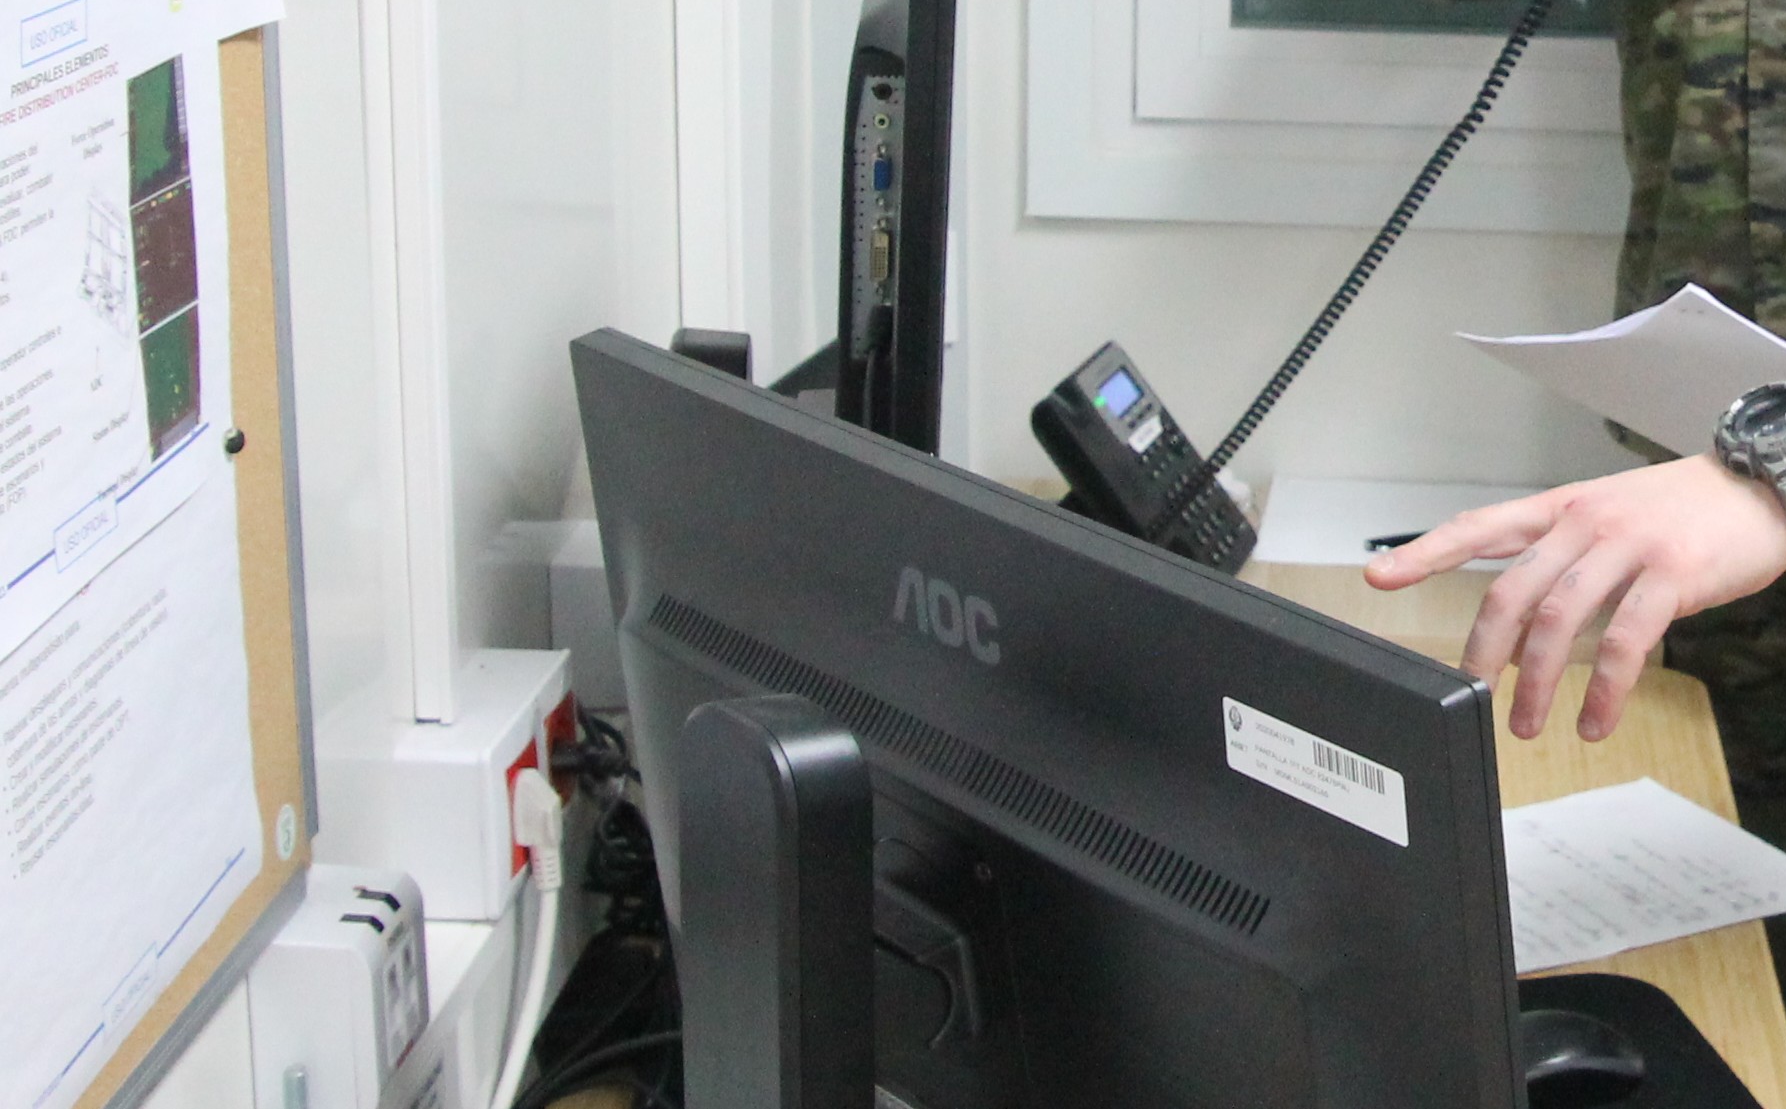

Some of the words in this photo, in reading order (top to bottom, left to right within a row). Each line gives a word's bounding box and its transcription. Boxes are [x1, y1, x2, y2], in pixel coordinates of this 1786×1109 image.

[10, 66, 64, 98] PRINCIPALES
[65, 44, 109, 76] ELEMENTOS
[18, 85, 74, 120] DISTRIBUTION
[893, 565, 1001, 665] AOC
